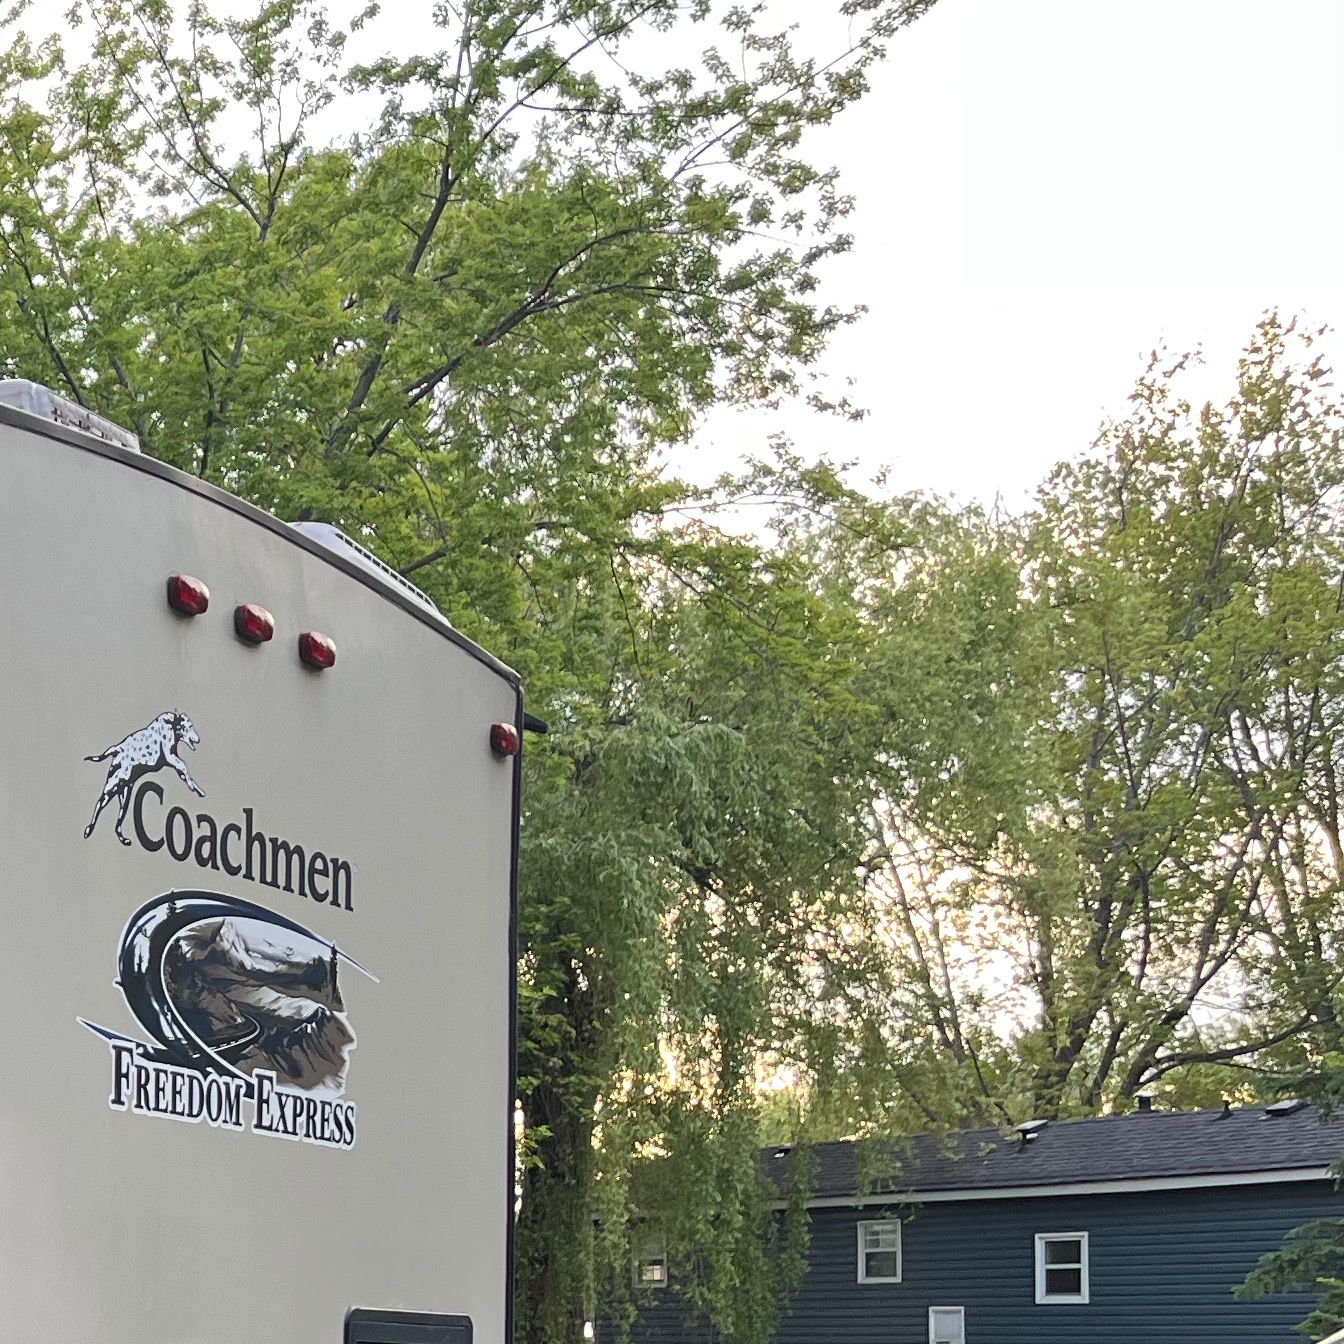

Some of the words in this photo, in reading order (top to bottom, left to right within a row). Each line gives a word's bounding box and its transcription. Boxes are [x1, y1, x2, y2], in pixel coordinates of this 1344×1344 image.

[132, 780, 354, 912] Coachmen
[112, 1046, 243, 1127] FREEDOM
[254, 1074, 355, 1146] EXPRESS
